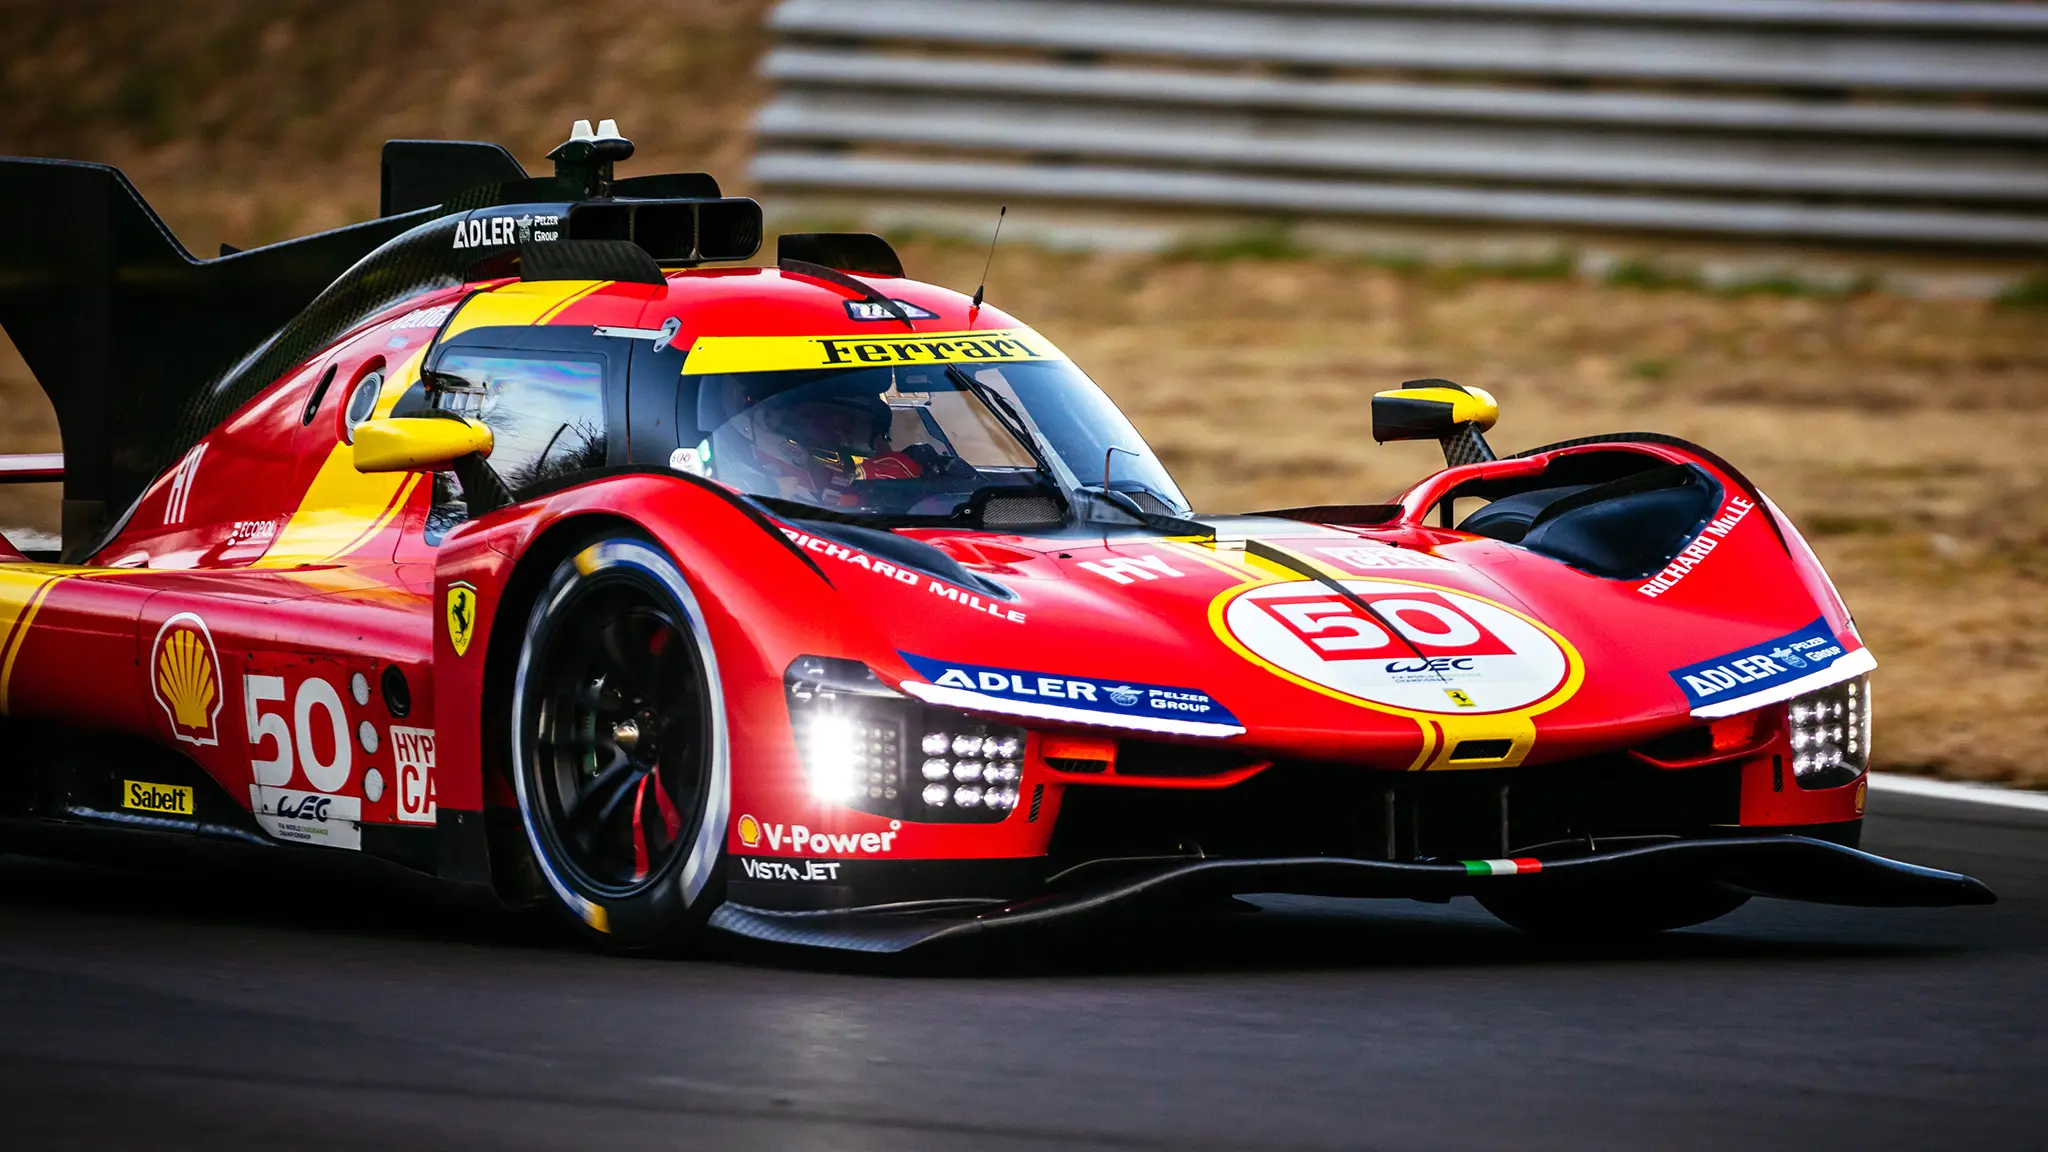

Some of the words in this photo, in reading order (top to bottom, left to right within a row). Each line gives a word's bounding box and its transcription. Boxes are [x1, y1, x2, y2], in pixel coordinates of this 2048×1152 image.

[453, 216, 515, 249] ADLER
[534, 215, 558, 226] PELZER
[534, 230, 559, 242] GROUP
[816, 333, 1041, 364] Ferrari
[163, 441, 210, 525] HY
[239, 520, 275, 538] ECOPOL
[1637, 536, 1718, 598] RICHARD
[1706, 496, 1755, 541] MILLE
[1076, 555, 1185, 585] HY
[928, 581, 1027, 625] MILLE
[1268, 598, 1480, 652] 50
[1789, 635, 1828, 652] PELZER
[1804, 645, 1841, 662] GROUP
[1385, 658, 1474, 673] WEC
[1682, 653, 1788, 697] ADLER
[933, 668, 1098, 702] ADLER
[1149, 690, 1209, 702] PELZER
[1150, 697, 1210, 713] GROUP
[243, 674, 352, 793] 50
[394, 732, 436, 764] HYP
[130, 782, 186, 812] Sabelt
[401, 764, 436, 814] CA
[277, 795, 332, 822] WEC
[763, 822, 897, 854] V-Power
